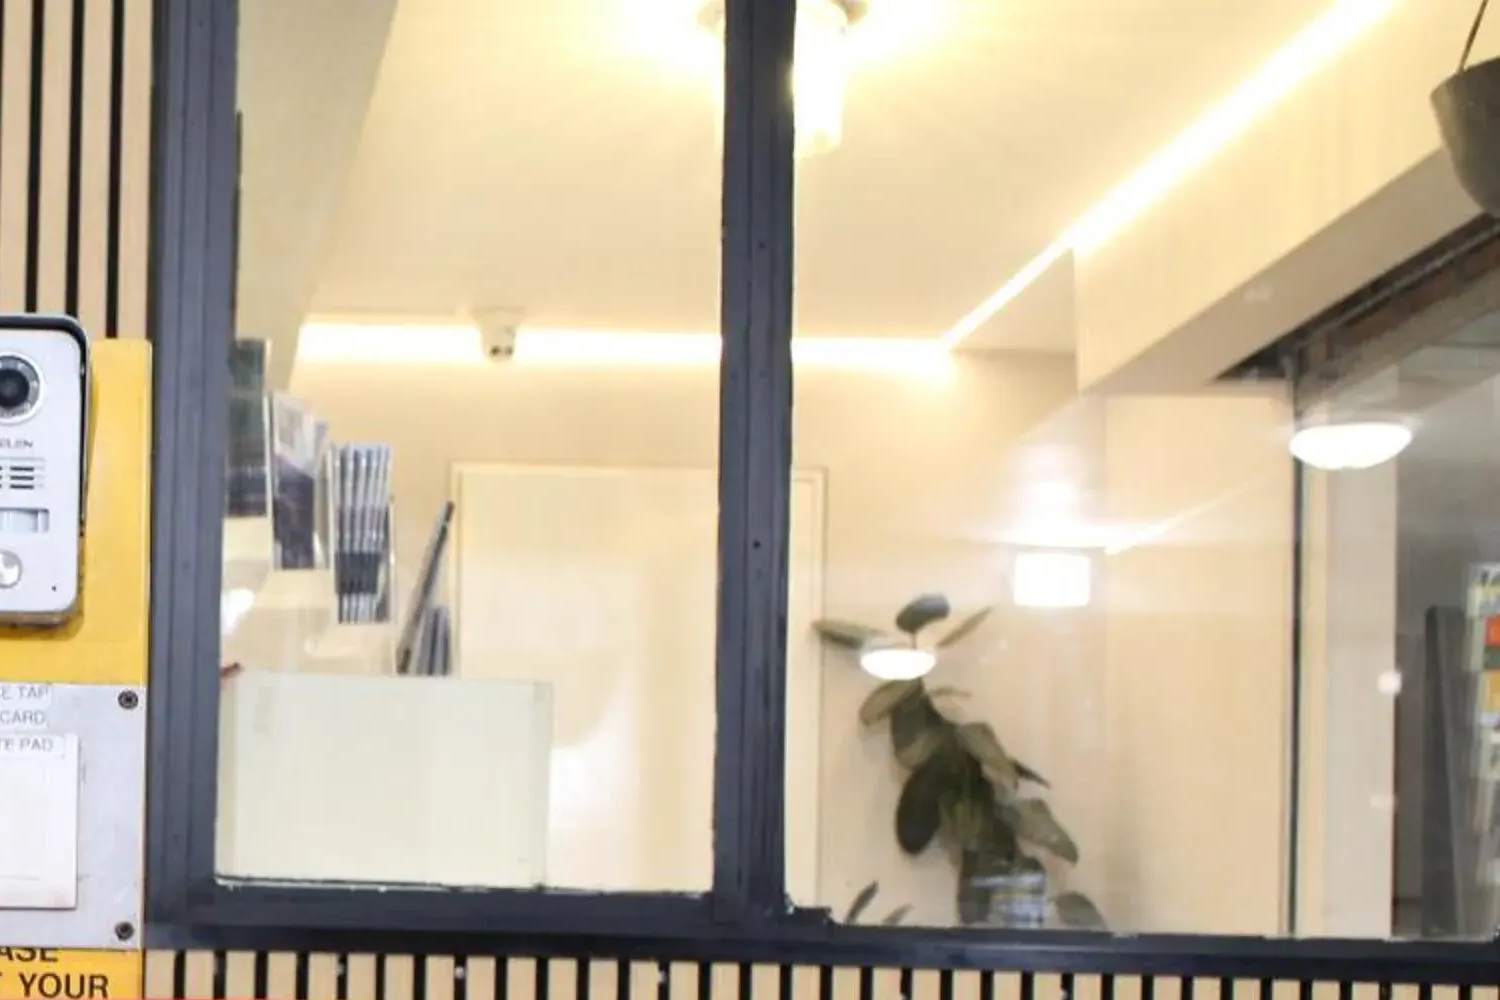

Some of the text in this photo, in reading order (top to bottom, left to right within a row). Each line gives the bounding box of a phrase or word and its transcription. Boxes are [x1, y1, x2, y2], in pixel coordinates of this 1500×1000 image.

[17, 685, 50, 699] TAP
[0, 710, 46, 726] CARD
[19, 738, 53, 752] PAD
[17, 972, 109, 999] YOUR
